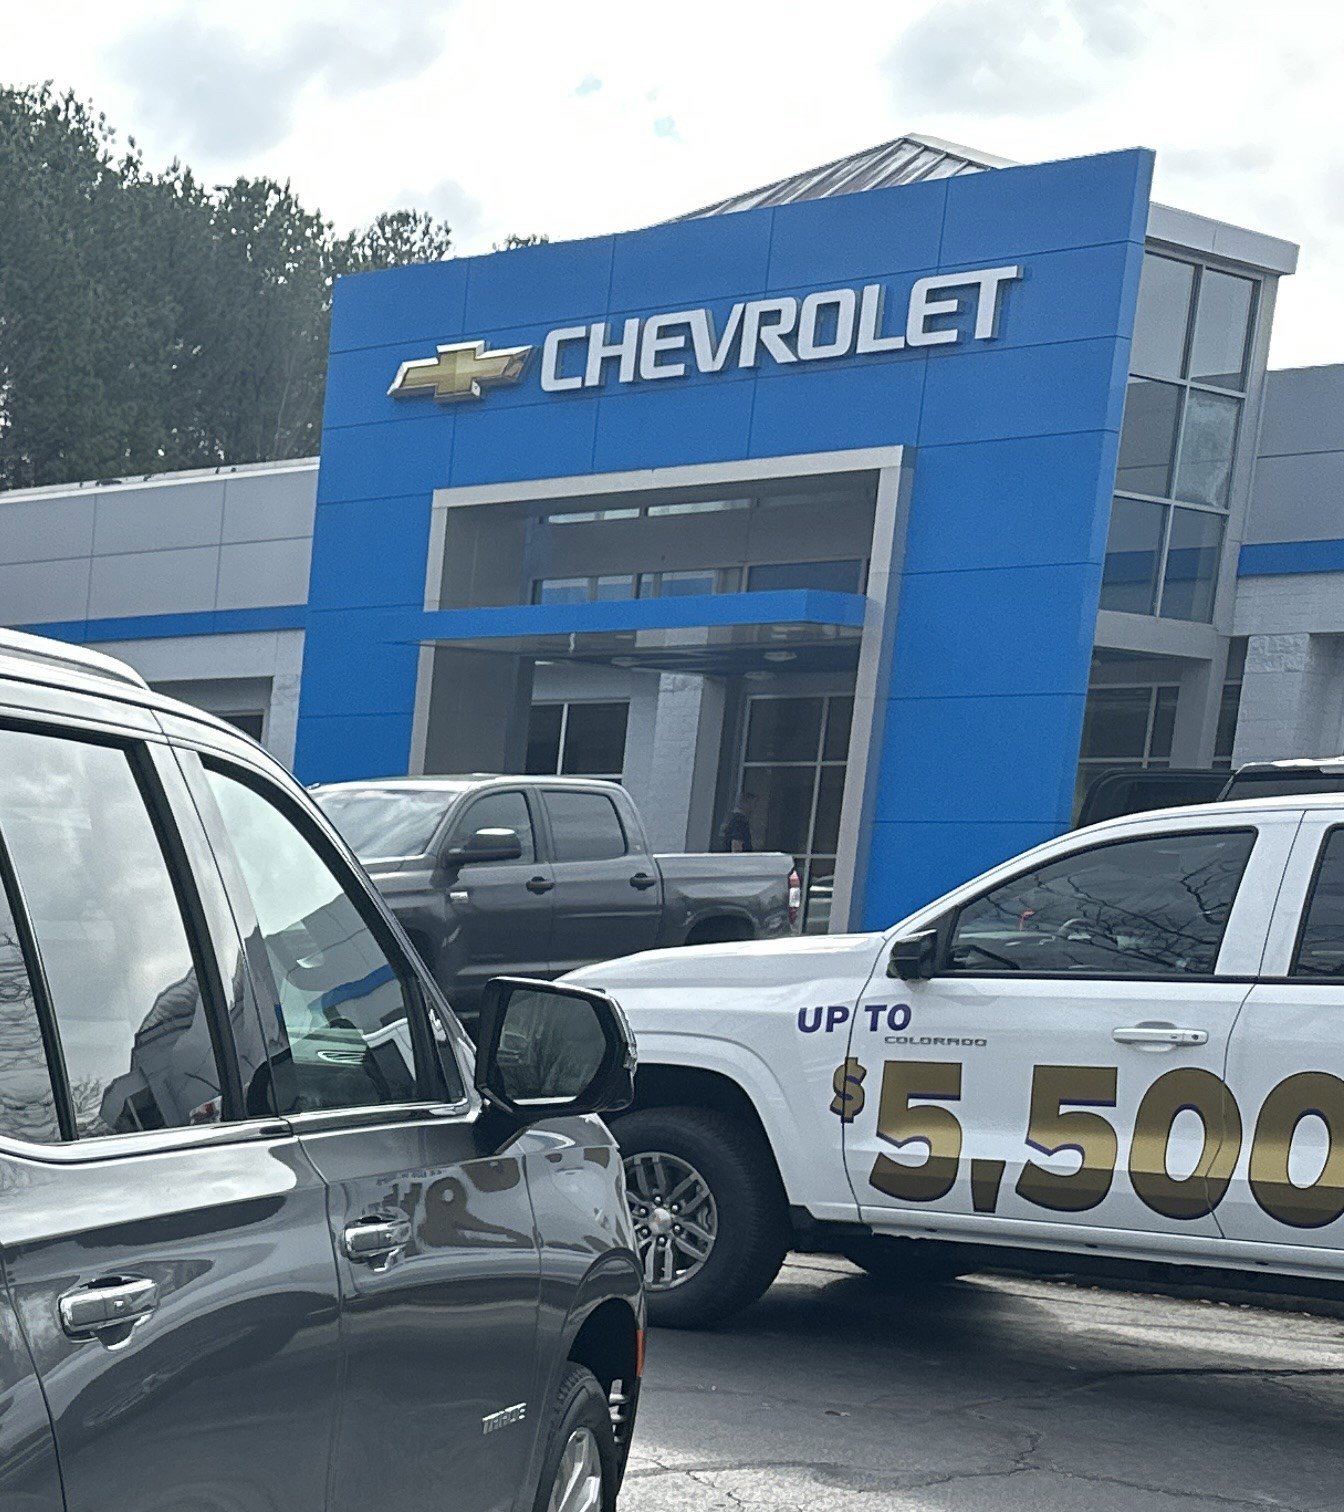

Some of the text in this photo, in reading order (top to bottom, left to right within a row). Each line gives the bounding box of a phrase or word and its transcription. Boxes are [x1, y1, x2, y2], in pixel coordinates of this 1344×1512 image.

[541, 265, 1021, 392] CHEVROLET
[797, 1003, 912, 1033] UP TO
[884, 1036, 988, 1047] COLORADO
[830, 1057, 1344, 1229] $5,500
